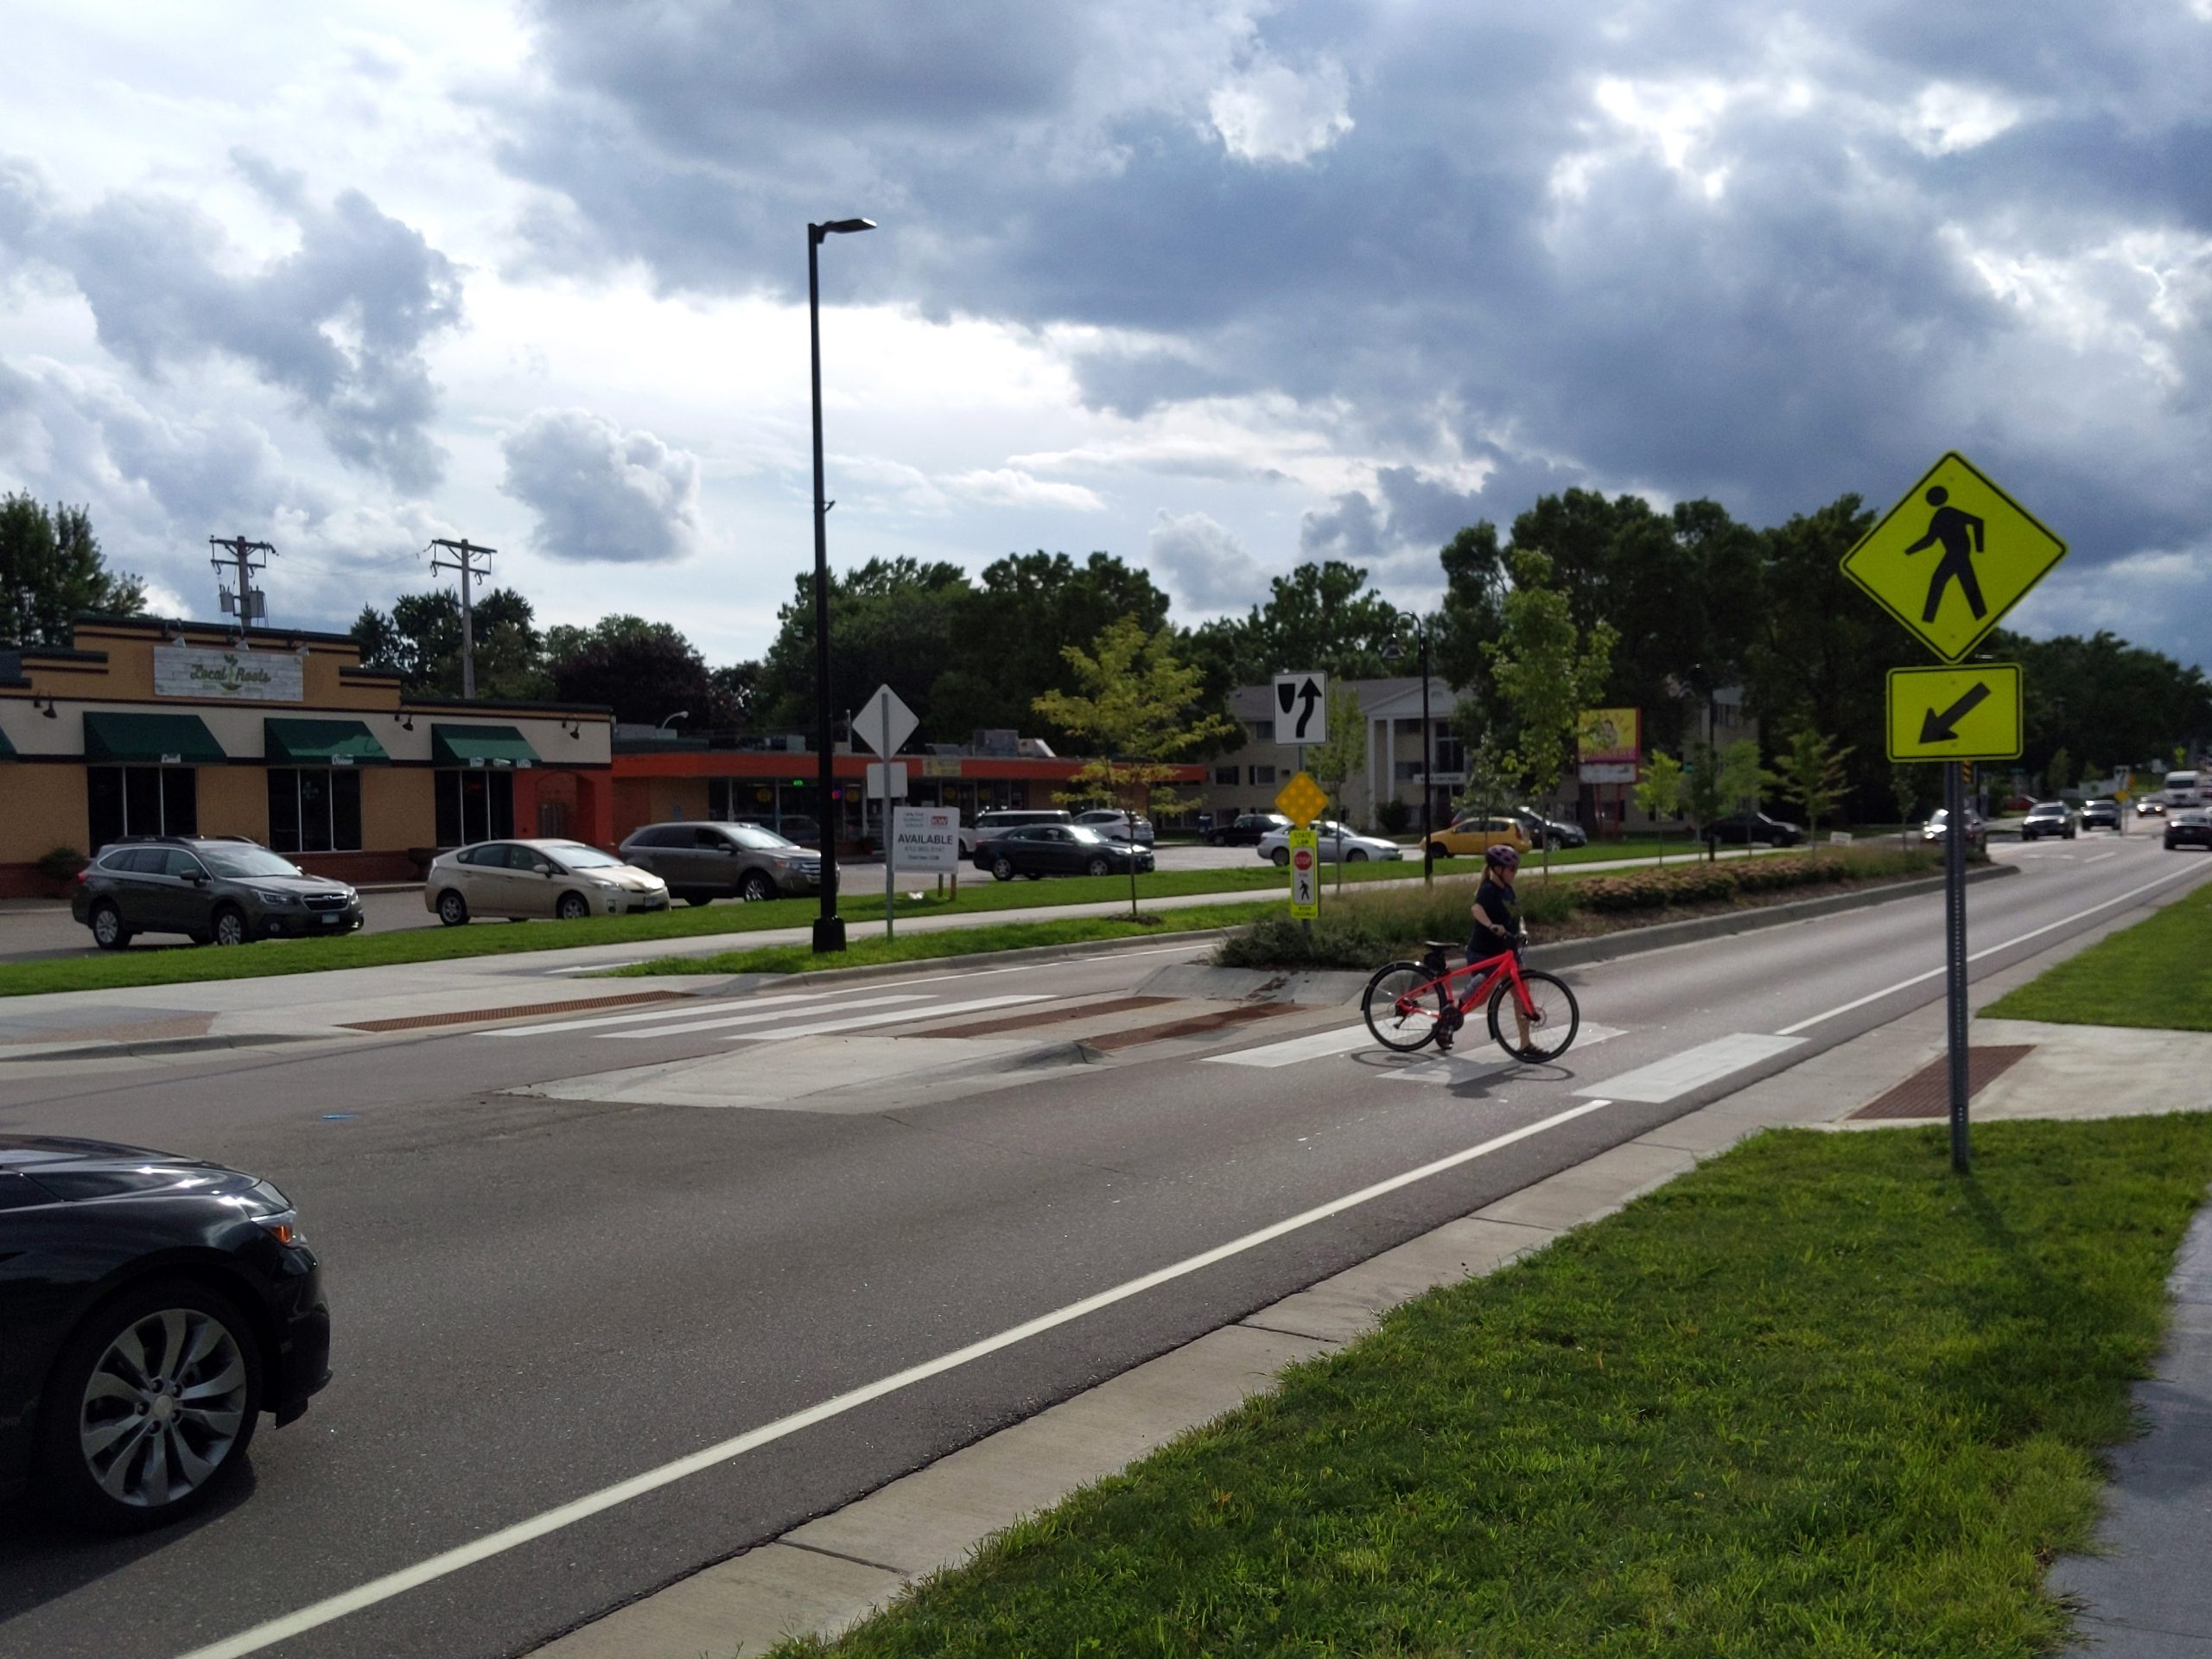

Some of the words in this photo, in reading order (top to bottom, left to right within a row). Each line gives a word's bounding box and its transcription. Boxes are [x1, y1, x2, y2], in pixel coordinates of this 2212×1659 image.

[190, 664, 227, 680] Local
[235, 667, 271, 683] Roots
[898, 833, 953, 845] AVAILABLE
[1295, 856, 1311, 865] STOP
